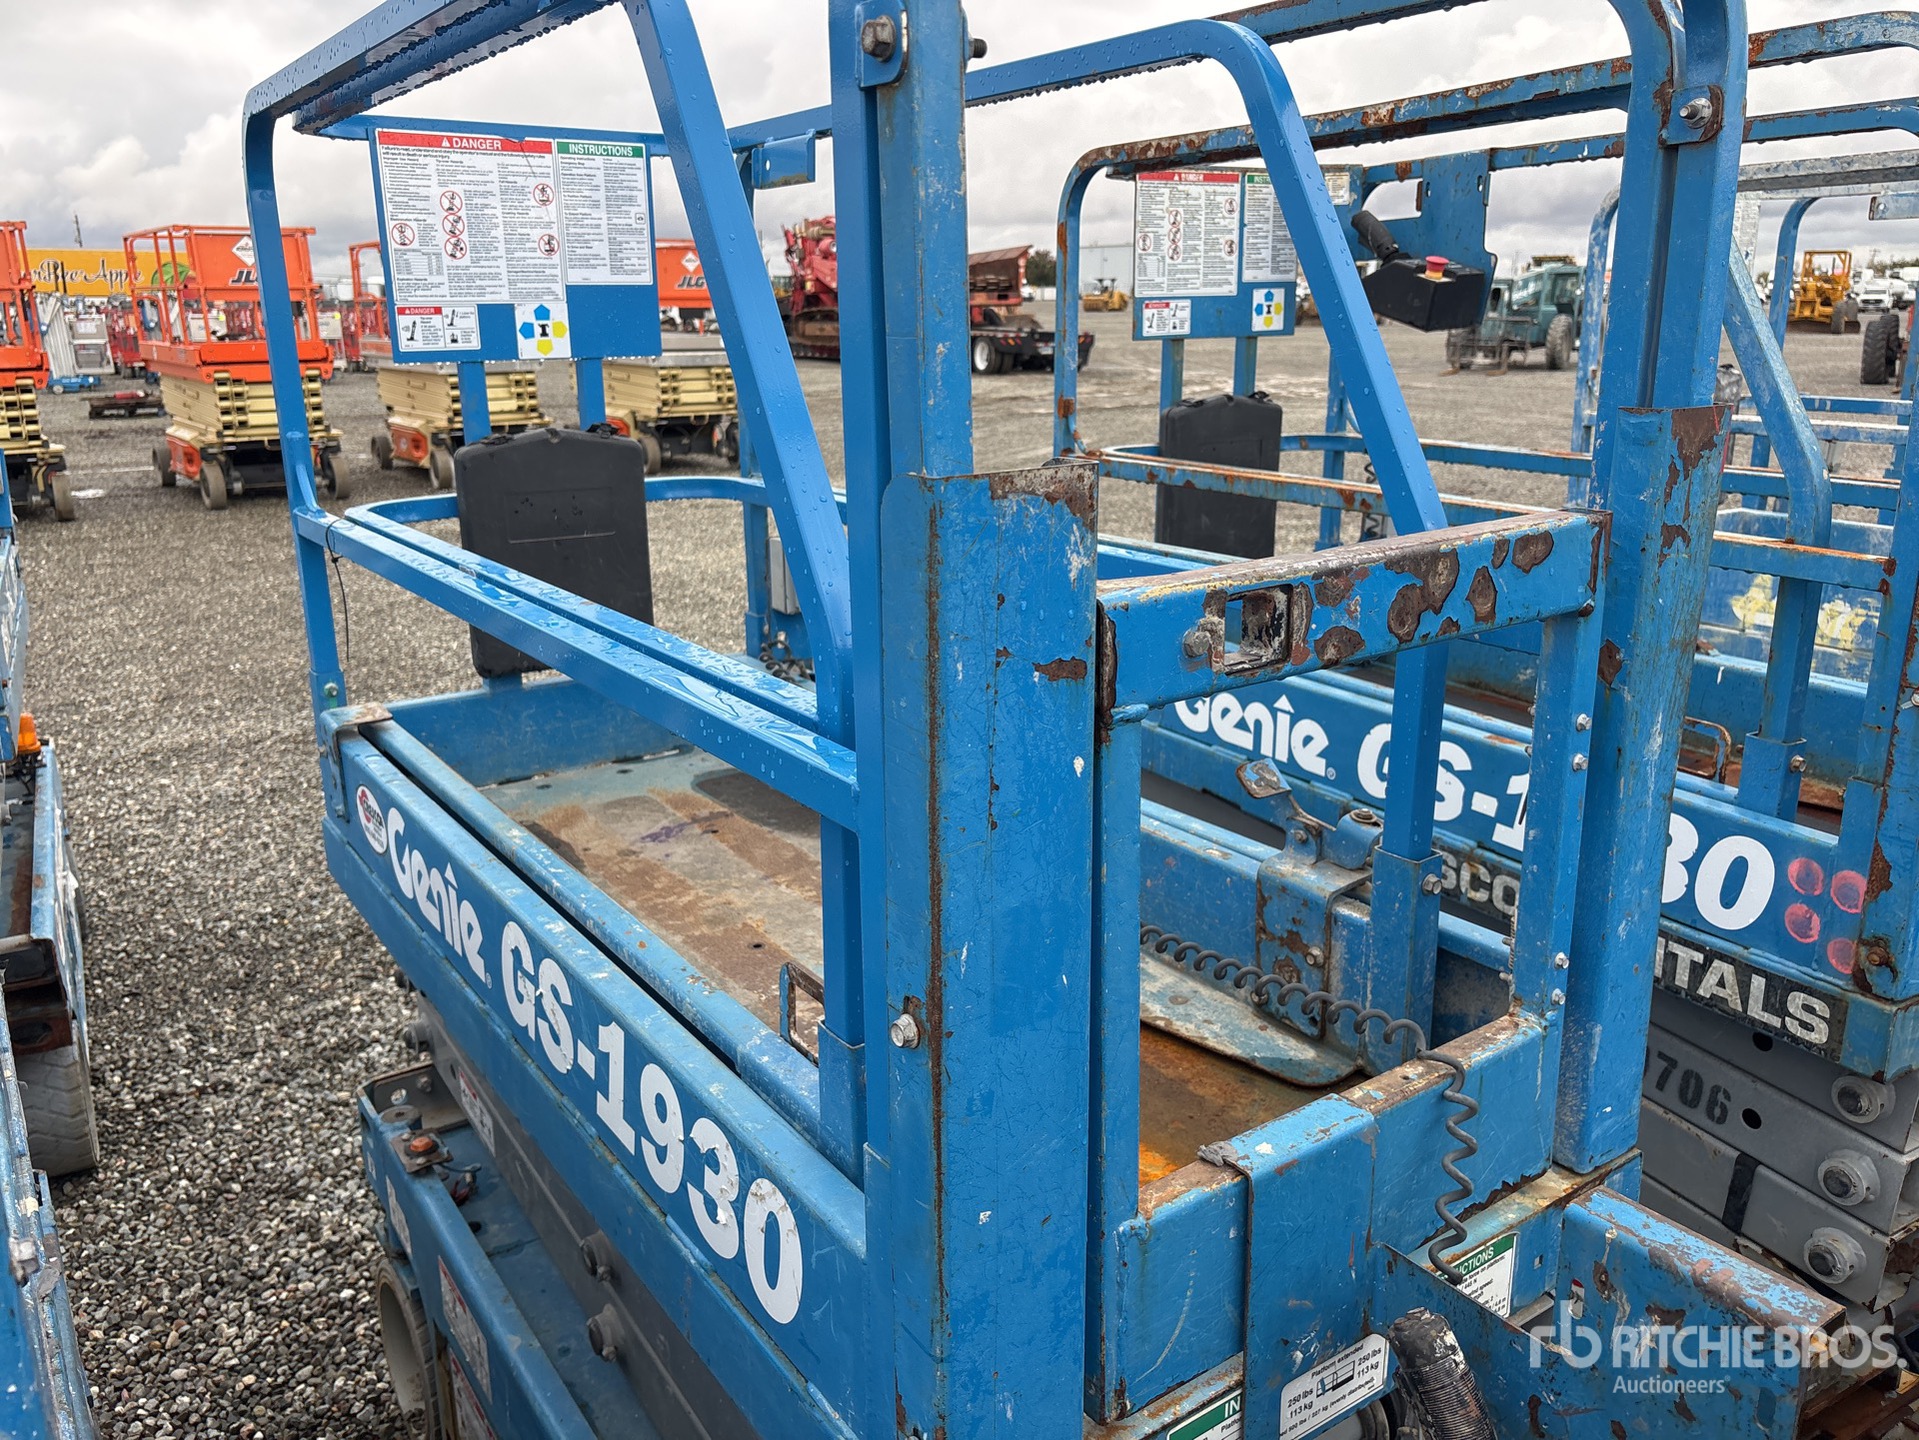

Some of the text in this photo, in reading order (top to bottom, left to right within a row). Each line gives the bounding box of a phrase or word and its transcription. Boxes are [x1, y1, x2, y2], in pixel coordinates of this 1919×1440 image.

[452, 137, 502, 150] DANGER
[568, 143, 633, 156] INSTRUCTIONS
[84, 257, 146, 291] Appe
[230, 269, 258, 284] JL
[677, 276, 706, 289] JLG
[1174, 691, 1329, 778] Genie
[1656, 938, 1831, 1045] TALS
[387, 807, 803, 1324] Genie GS-1930
[1655, 1050, 1732, 1126] 706
[1311, 1343, 1364, 1379] Platform extended
[1357, 1347, 1382, 1367] 250 lbs
[1357, 1360, 1380, 1379] 113 kg
[1287, 1387, 1314, 1409] 250 lbs
[1289, 1400, 1314, 1419] 113 kg
